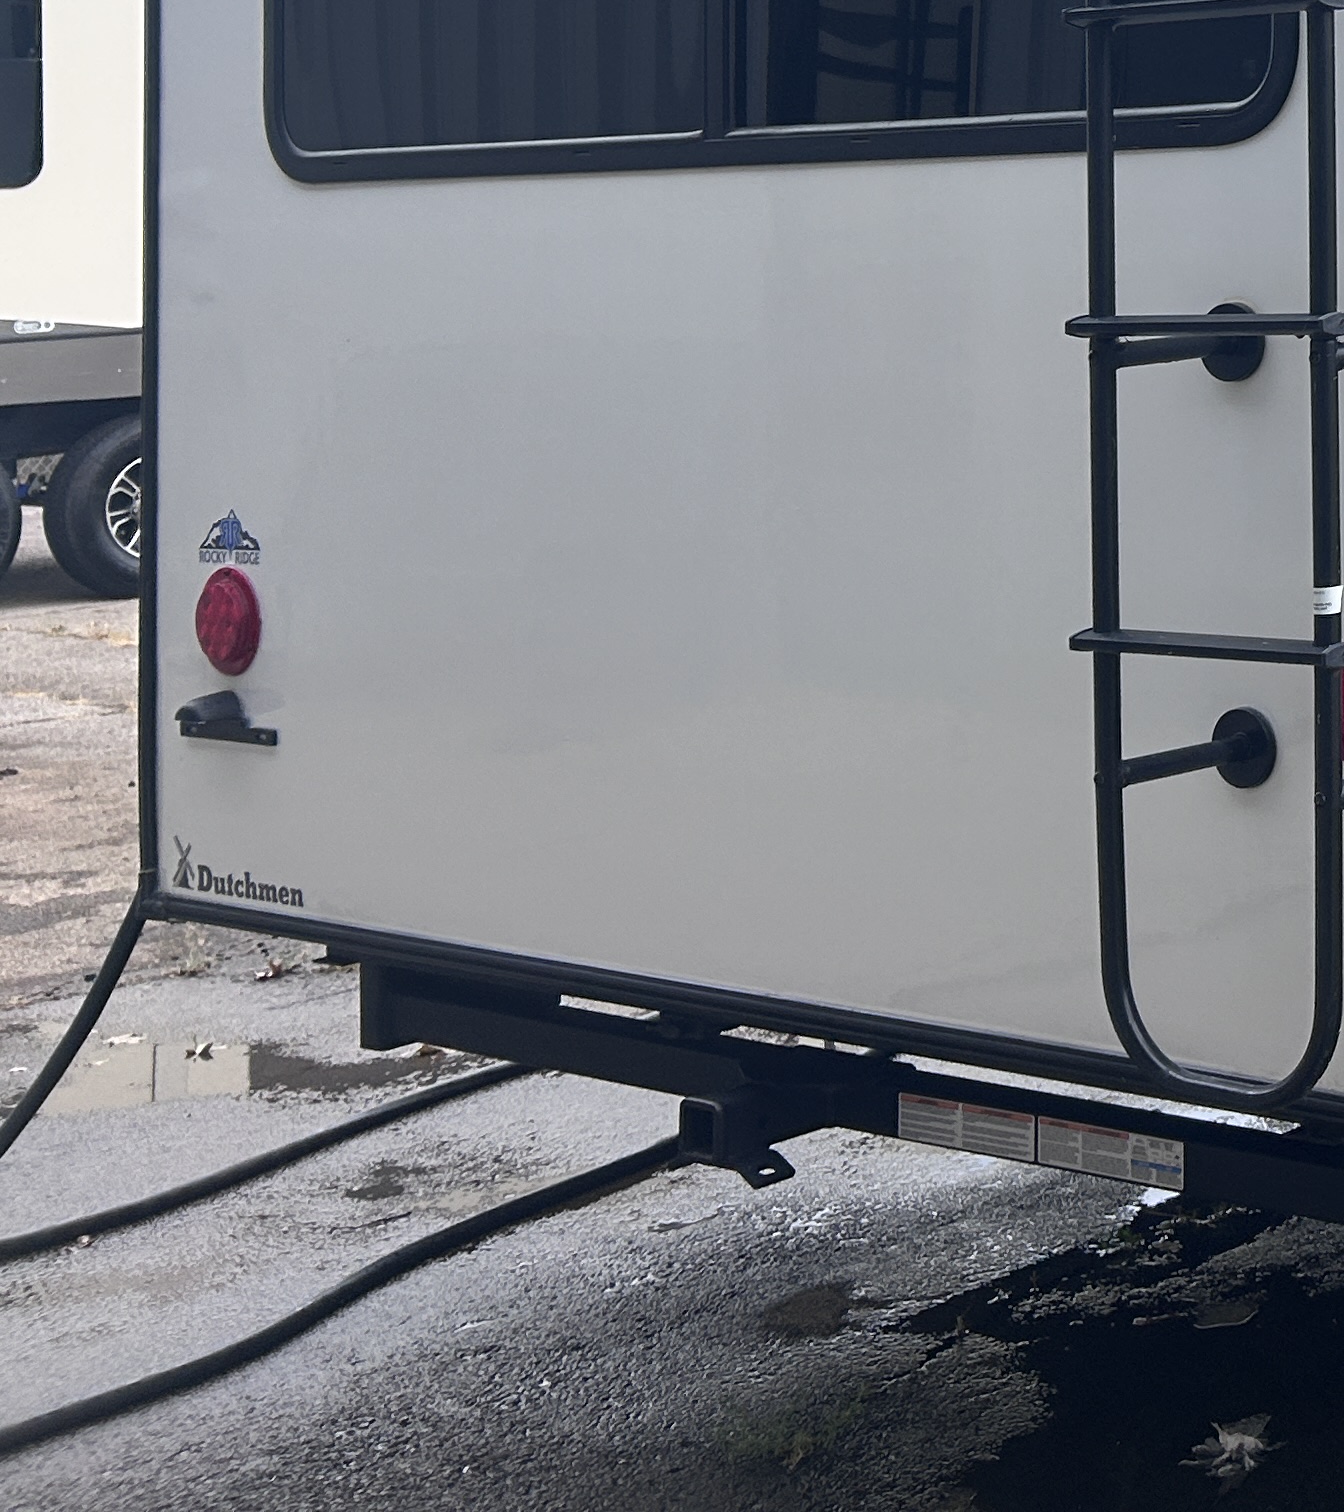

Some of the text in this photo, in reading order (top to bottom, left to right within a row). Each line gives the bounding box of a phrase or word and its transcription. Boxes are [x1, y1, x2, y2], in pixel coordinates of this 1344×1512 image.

[199, 550, 260, 565] ROCKY RIDGE
[197, 864, 305, 908] Dutchmen
